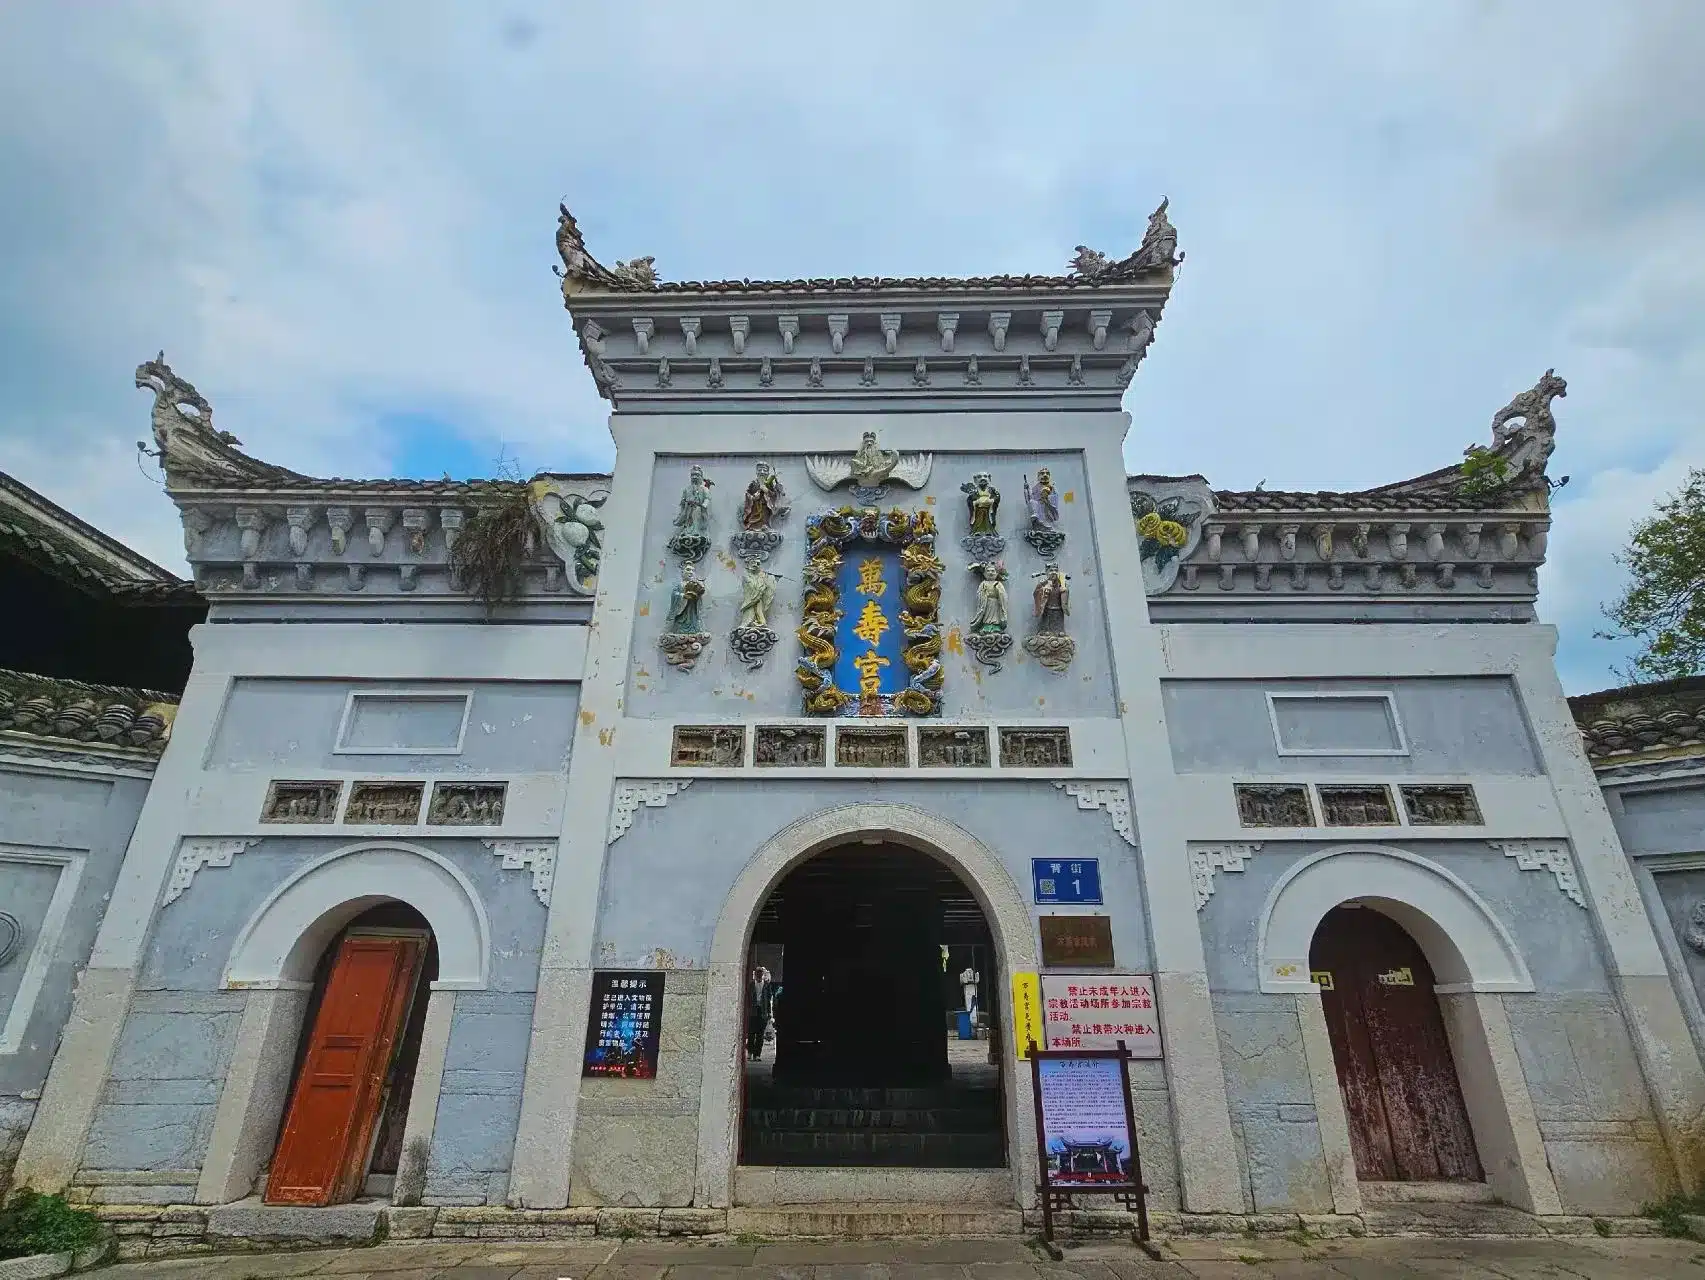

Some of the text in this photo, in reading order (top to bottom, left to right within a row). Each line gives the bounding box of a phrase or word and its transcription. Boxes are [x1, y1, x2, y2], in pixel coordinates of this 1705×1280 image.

[1050, 863, 1082, 874] 背街
[1072, 879, 1081, 895] 1
[611, 979, 647, 989] 温馨提示
[1068, 986, 1151, 996] 禁止未成年人进入
[603, 994, 653, 1002] 您已进入文物保
[1048, 998, 1152, 1009] 宗教活动场所参加宗教
[1049, 1011, 1073, 1021] 活动。
[1071, 1024, 1155, 1035] 禁止携带火种进入
